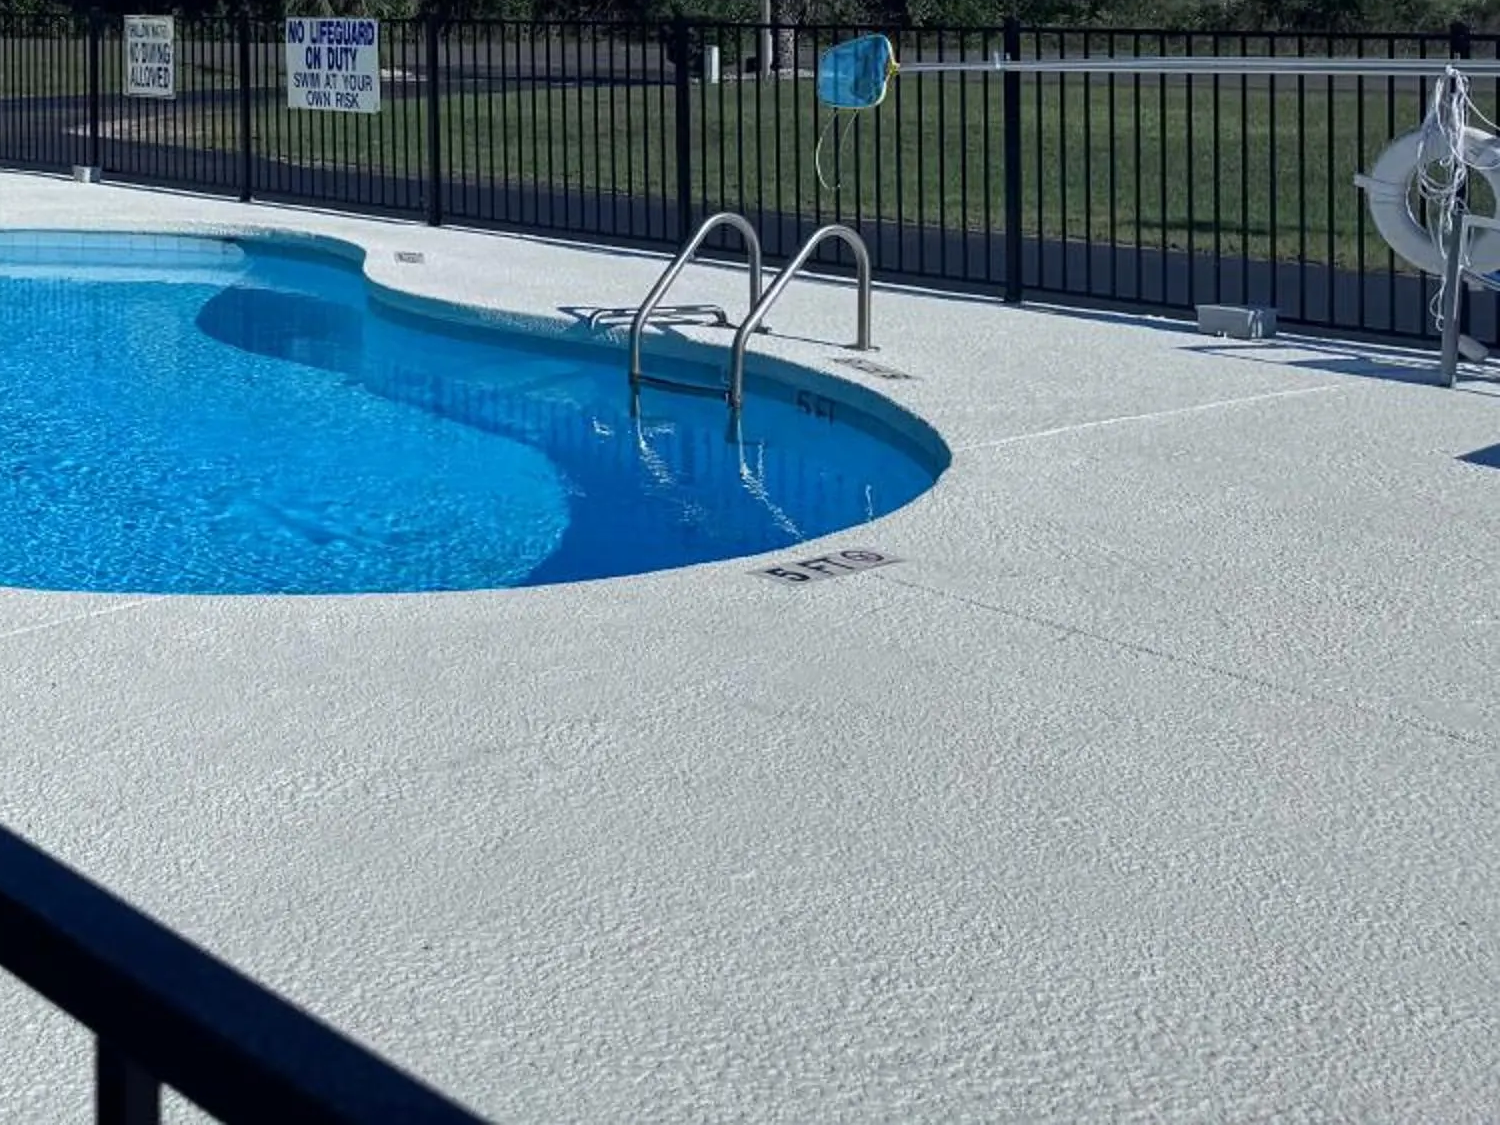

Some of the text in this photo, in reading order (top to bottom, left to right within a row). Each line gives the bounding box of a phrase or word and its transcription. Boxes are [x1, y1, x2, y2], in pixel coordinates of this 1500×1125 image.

[287, 20, 375, 46] NO LIFEGUARD
[305, 46, 357, 72] ON DUTY
[130, 65, 171, 89] ALLOWED
[293, 72, 373, 92] SWIM AT YOUR
[306, 90, 360, 109] OWN RISK
[765, 557, 856, 581] 5 FT
